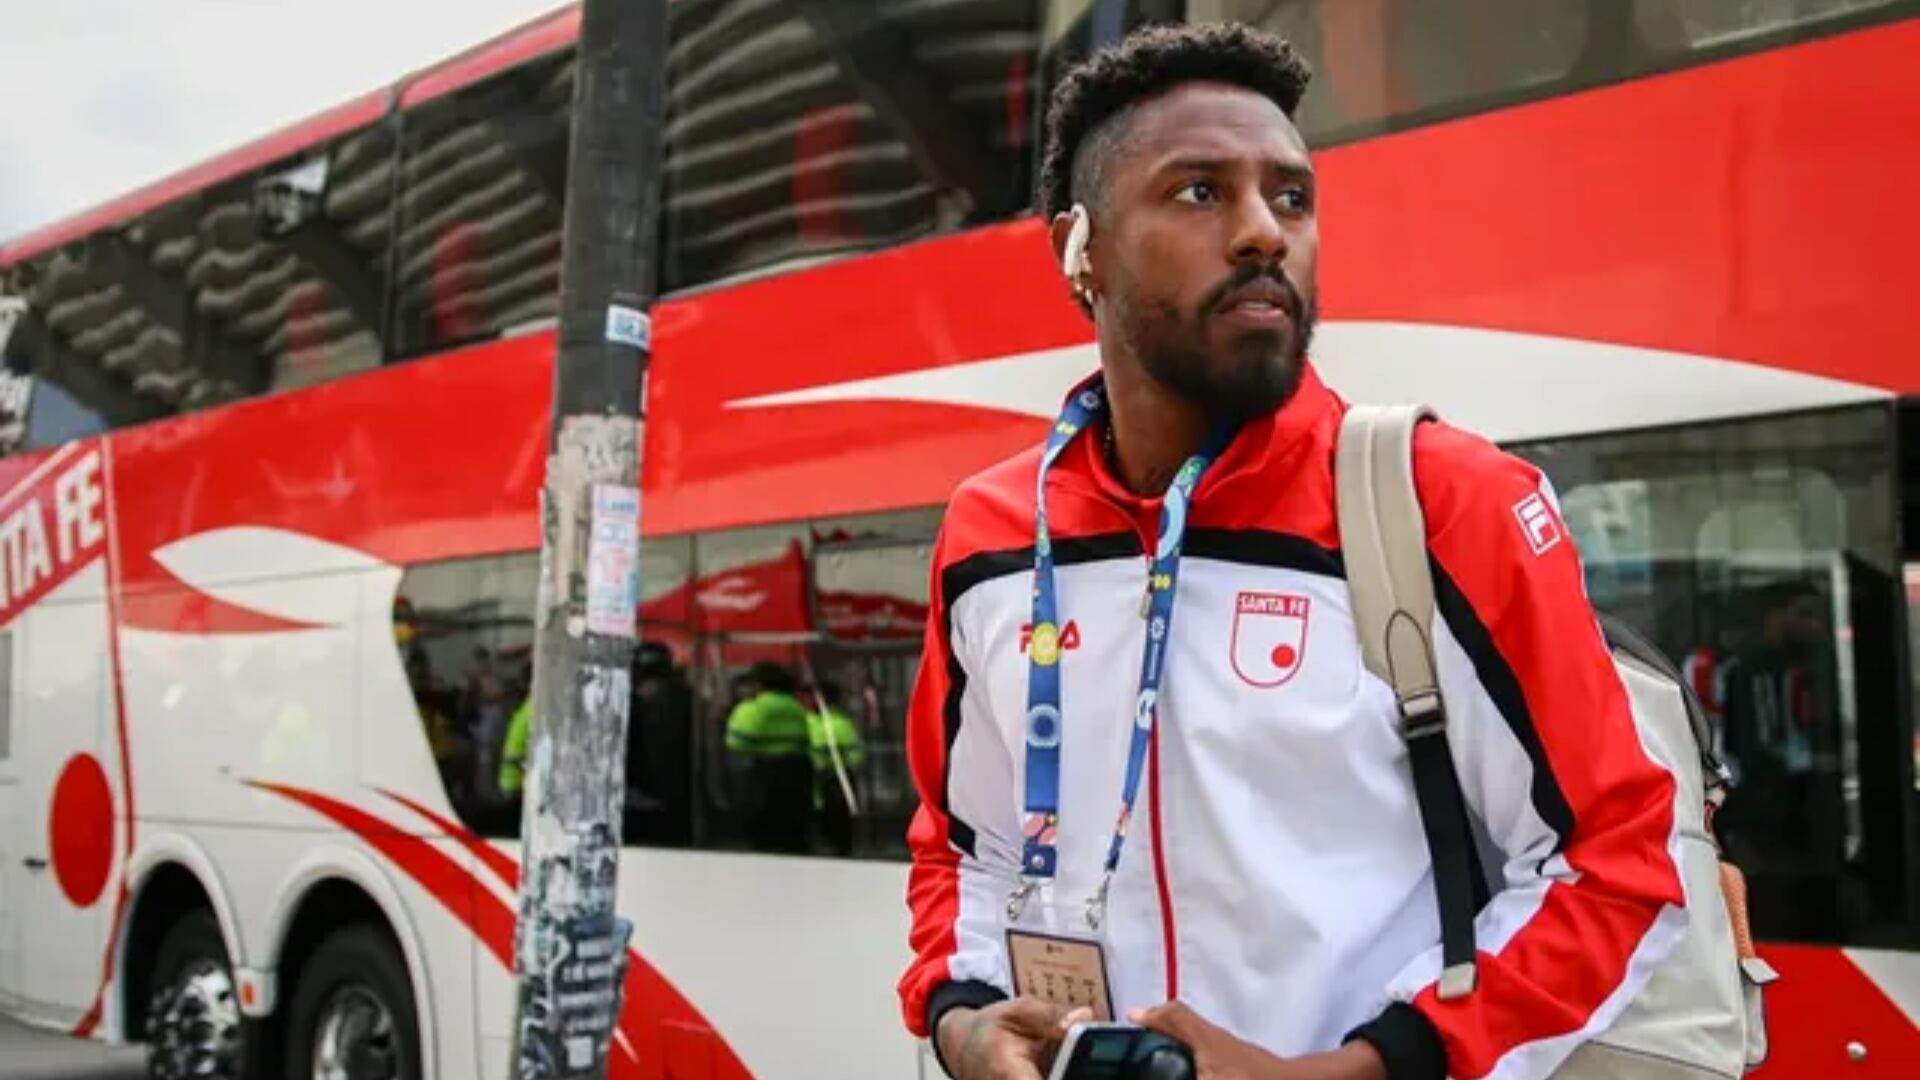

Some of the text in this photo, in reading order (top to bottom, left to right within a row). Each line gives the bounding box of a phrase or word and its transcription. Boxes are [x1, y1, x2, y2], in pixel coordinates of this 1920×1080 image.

[0, 450, 104, 608] TA FE
[1240, 594, 1307, 616] SANTA FE
[1019, 619, 1080, 653] FA
